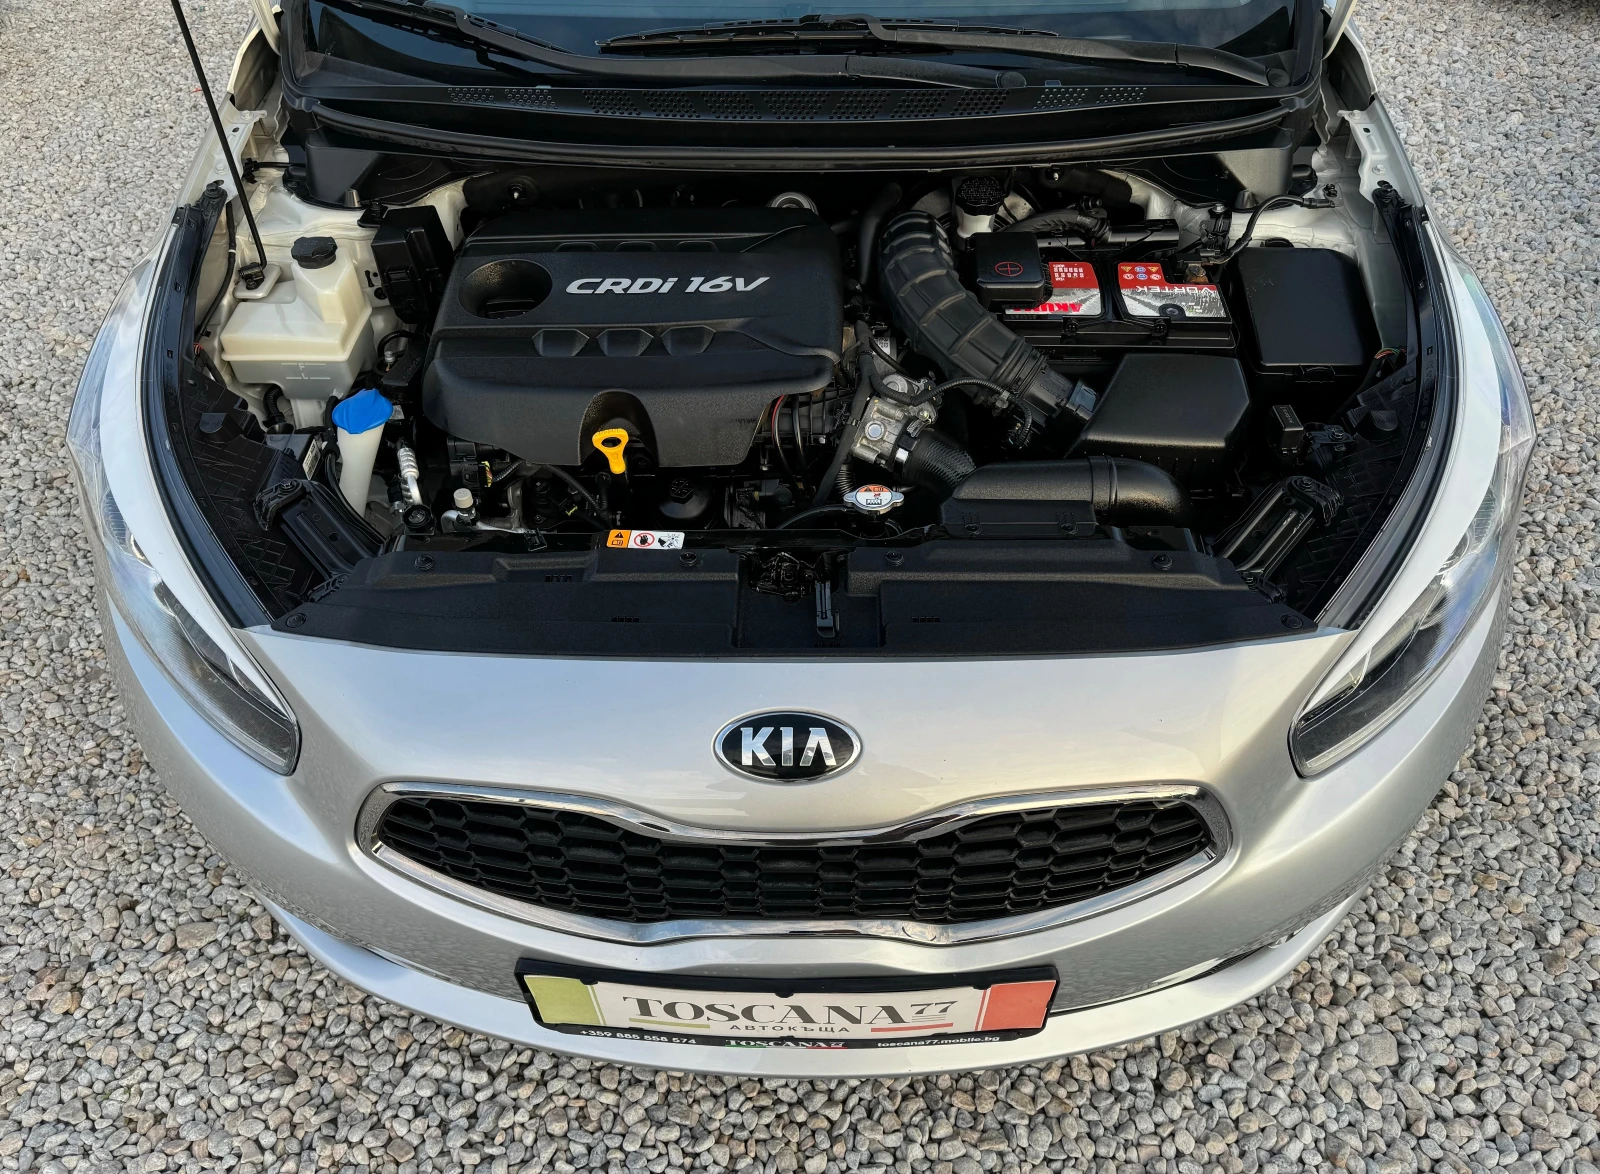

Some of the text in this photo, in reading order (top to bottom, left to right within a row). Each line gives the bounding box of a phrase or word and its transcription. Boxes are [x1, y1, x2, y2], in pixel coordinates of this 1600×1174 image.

[565, 276, 770, 294] CRDi 16V
[1136, 285, 1213, 294] VORTEK
[740, 726, 837, 766] KIA
[730, 1025, 850, 1033] АВТОКЪЩА
[877, 1036, 1000, 1048] toscana77.mobile.bg
